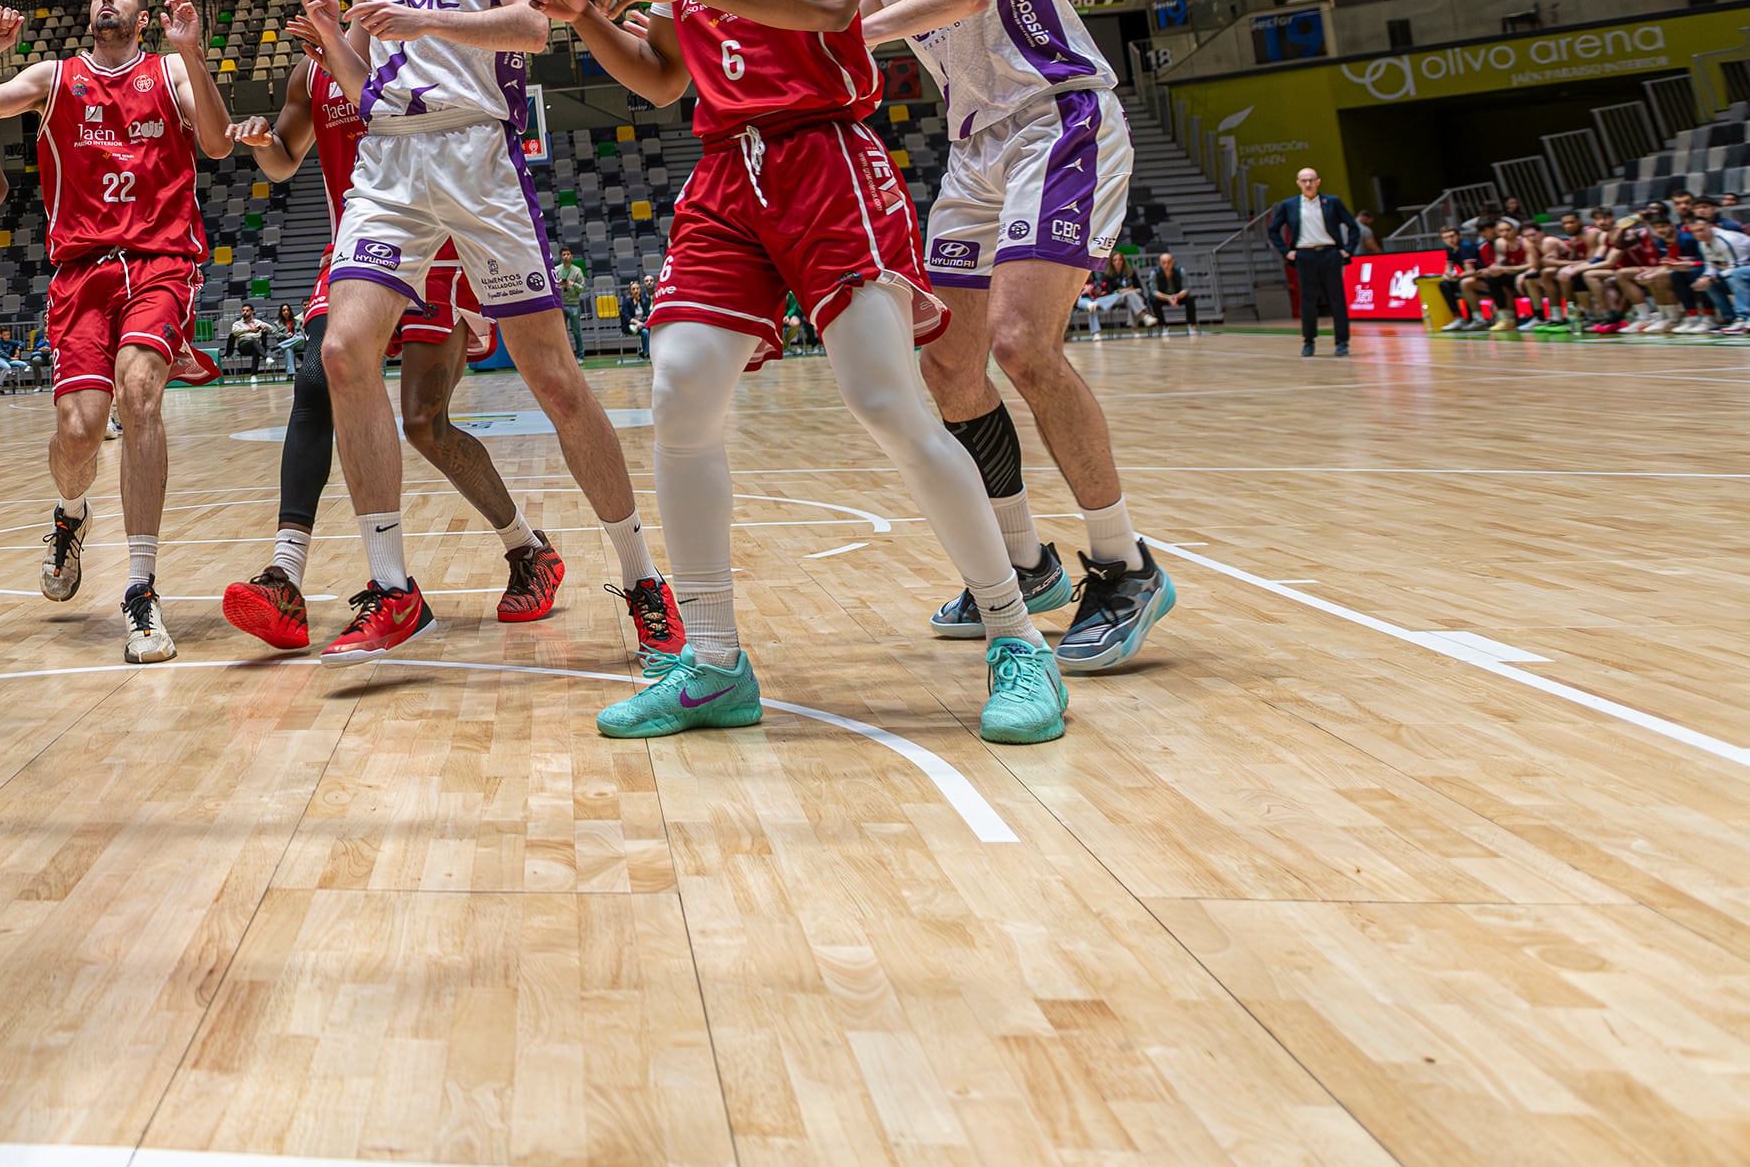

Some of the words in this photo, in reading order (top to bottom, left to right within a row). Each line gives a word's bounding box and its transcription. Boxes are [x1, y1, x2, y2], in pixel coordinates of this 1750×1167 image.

[1251, 15, 1293, 30] Sector
[1263, 10, 1325, 64] 19
[721, 40, 745, 81] 6
[1421, 46, 1516, 79] olivo
[1530, 26, 1665, 64] arena
[322, 99, 355, 122] Jaén
[102, 171, 137, 203] 22
[1052, 219, 1081, 240] CBC
[355, 255, 397, 269] HYUNDAI
[659, 255, 674, 283] 6
[931, 257, 975, 267] HYUNDAI
